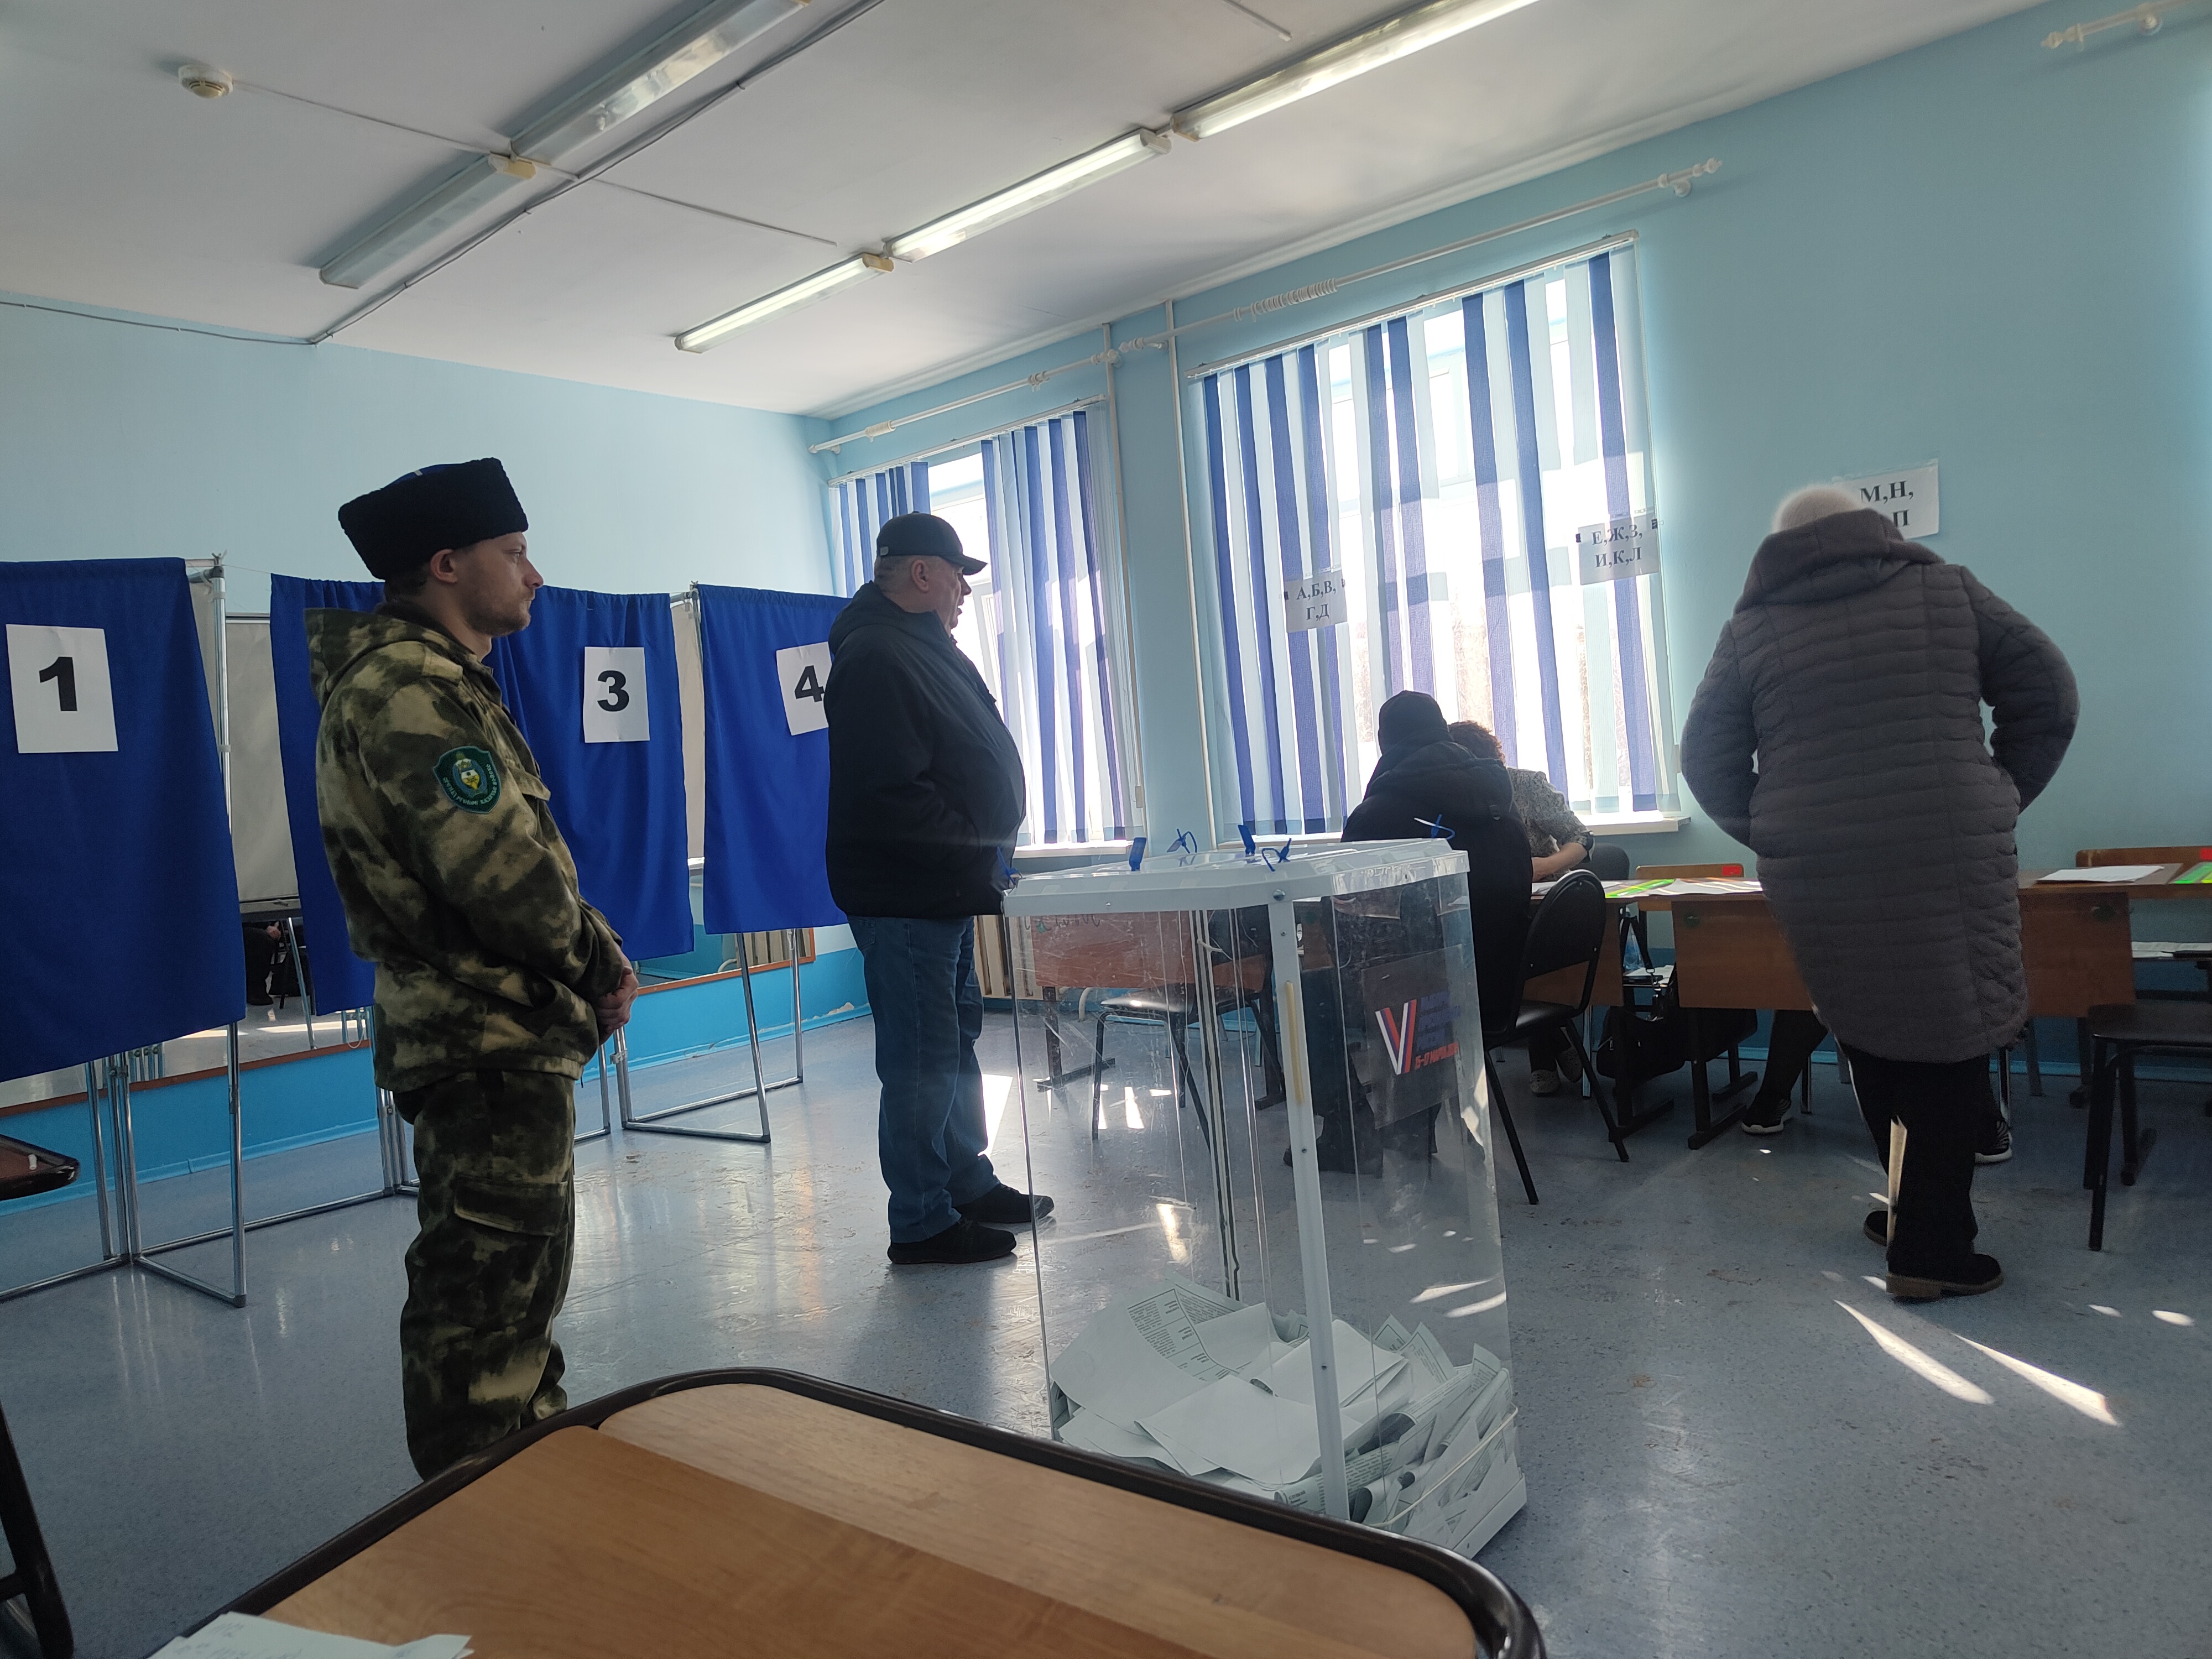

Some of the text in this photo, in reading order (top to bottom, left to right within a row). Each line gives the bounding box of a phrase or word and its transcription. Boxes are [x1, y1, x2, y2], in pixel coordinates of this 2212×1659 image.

[1859, 481, 1914, 504] М,Н,
[1592, 524, 1643, 546] Е,Ж,З,
[1594, 546, 1642, 568] И,К,Л
[1296, 580, 1336, 600] А,Б,В,
[1306, 603, 1330, 622] Г,Д
[39, 656, 78, 712] 1
[597, 670, 630, 712] 3
[794, 665, 825, 703] 4
